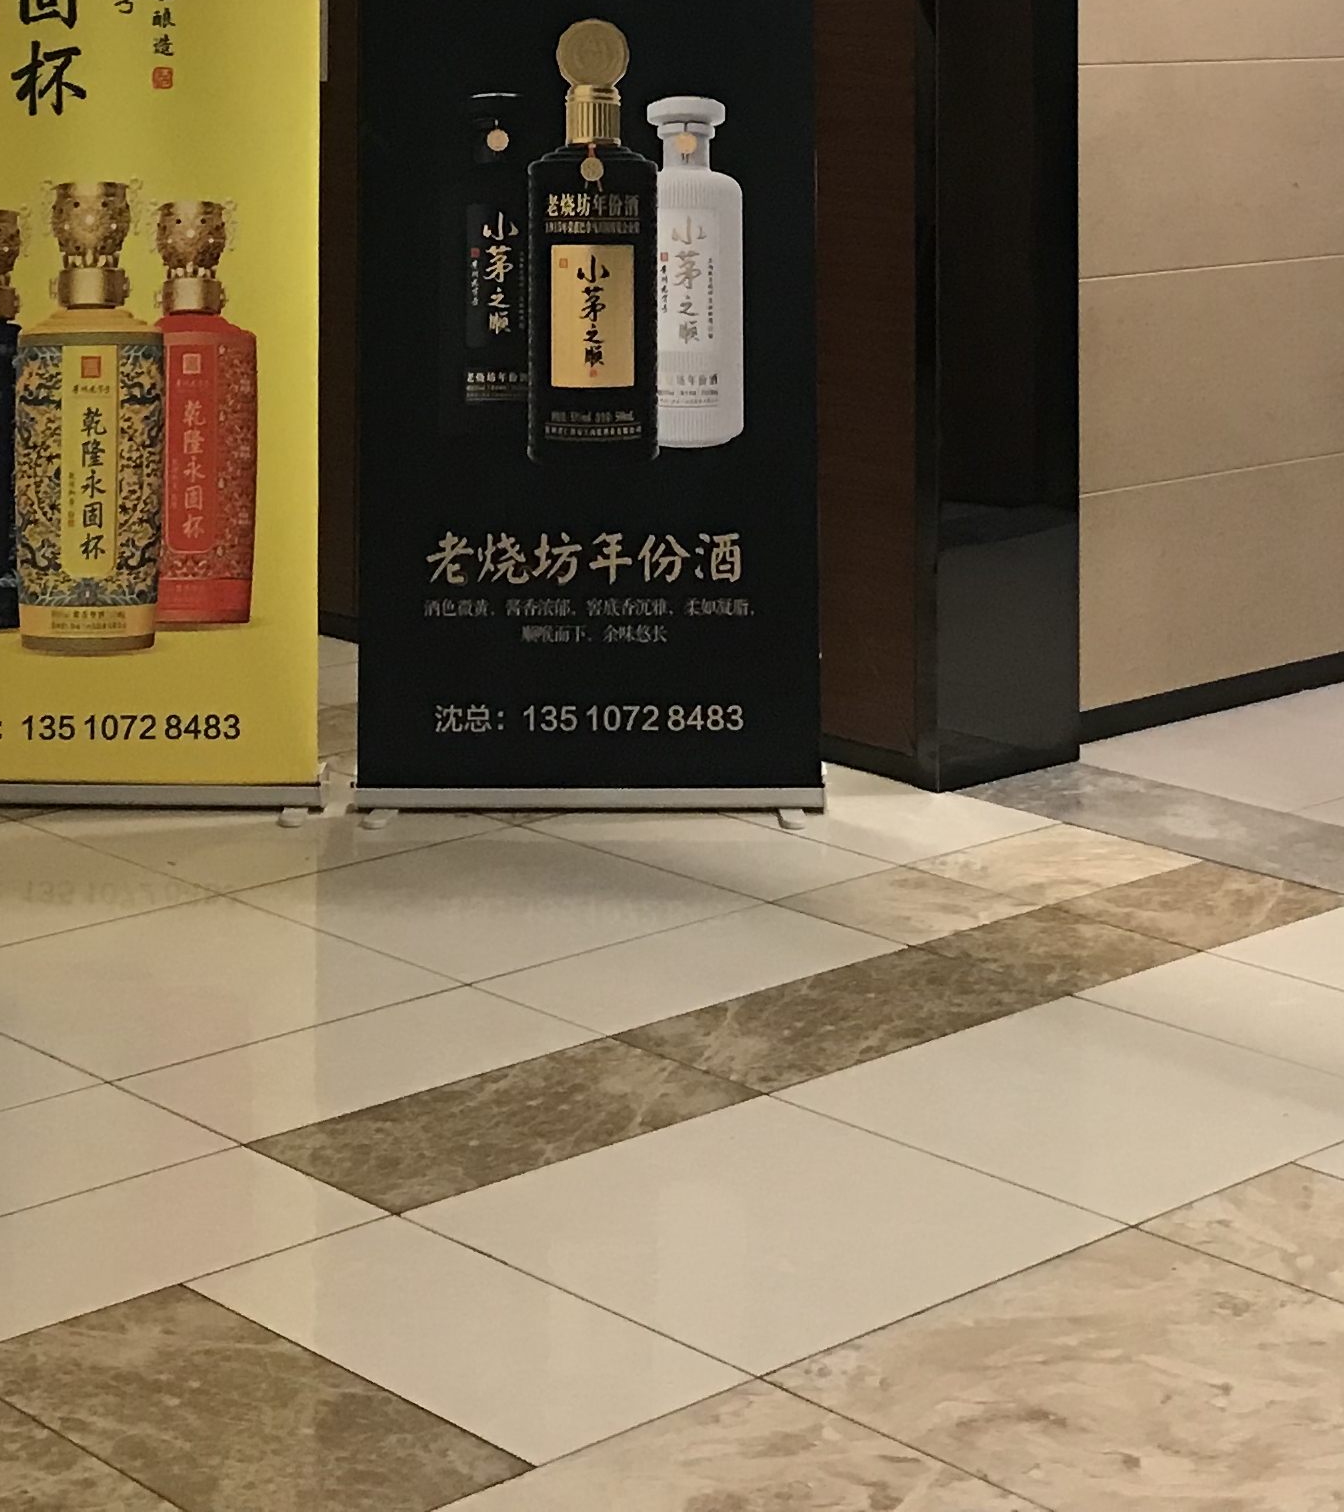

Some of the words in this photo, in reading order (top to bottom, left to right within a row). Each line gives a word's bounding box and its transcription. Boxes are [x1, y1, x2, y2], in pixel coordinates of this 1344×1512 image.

[79, 406, 108, 561] 乾隆永固杯
[426, 530, 744, 586] 老烧坊年份酒
